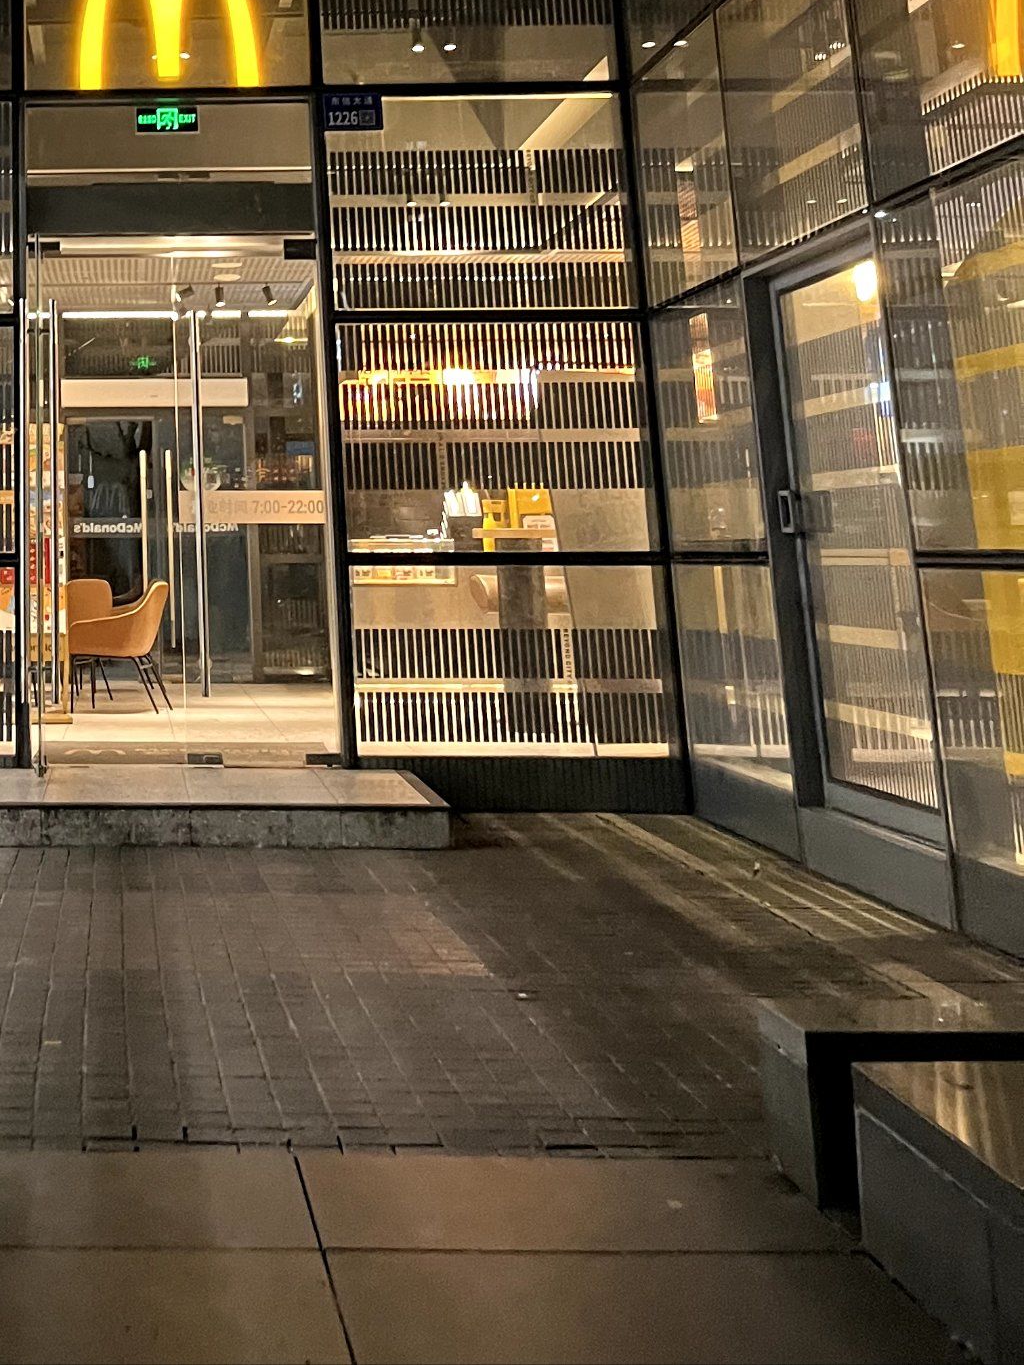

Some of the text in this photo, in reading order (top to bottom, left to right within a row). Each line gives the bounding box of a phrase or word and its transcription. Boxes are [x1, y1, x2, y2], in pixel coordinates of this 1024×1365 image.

[178, 114, 196, 124] EXIT
[328, 111, 358, 126] 1226
[253, 500, 324, 514] 7:00-22:00
